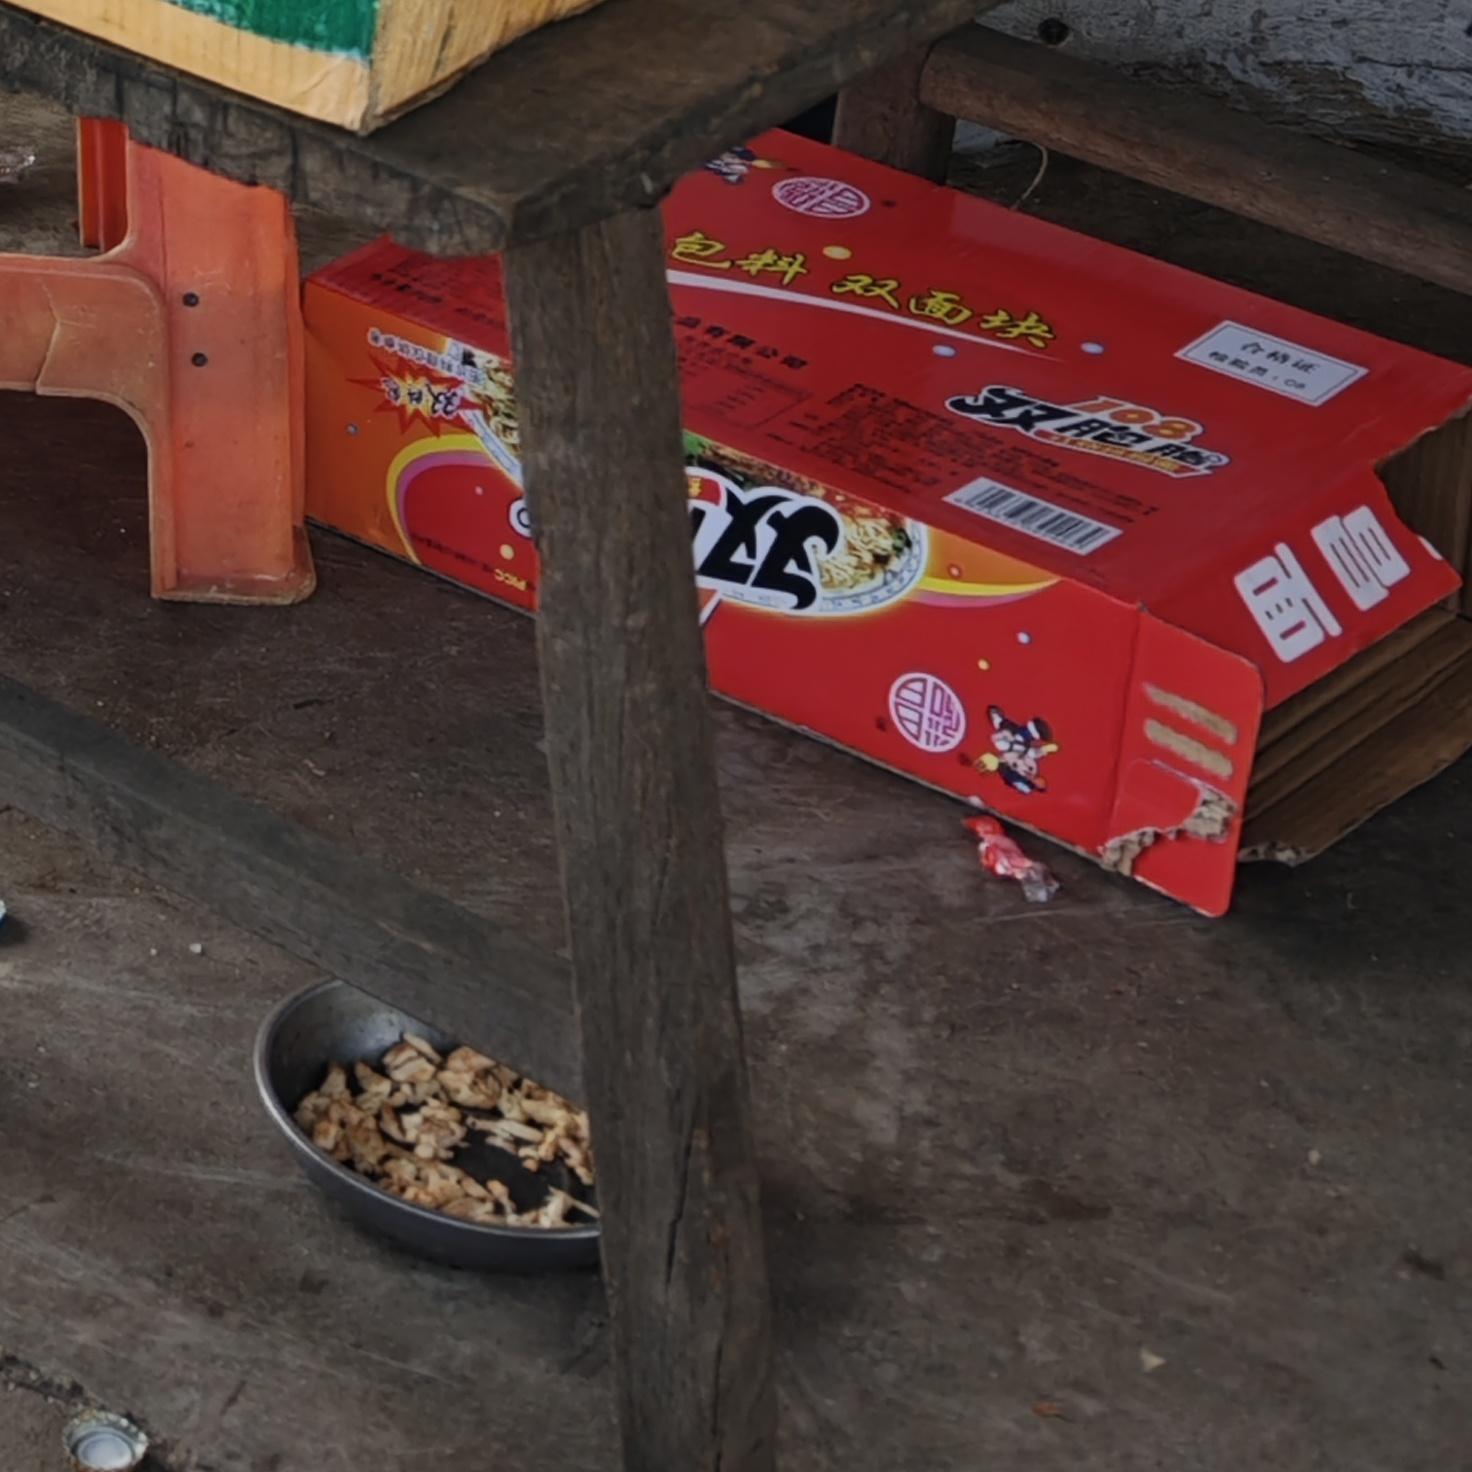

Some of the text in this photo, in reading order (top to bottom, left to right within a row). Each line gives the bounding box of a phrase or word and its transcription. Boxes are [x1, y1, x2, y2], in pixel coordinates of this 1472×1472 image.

[830, 272, 1057, 349] 双面块
[1240, 341, 1320, 374] 合格证
